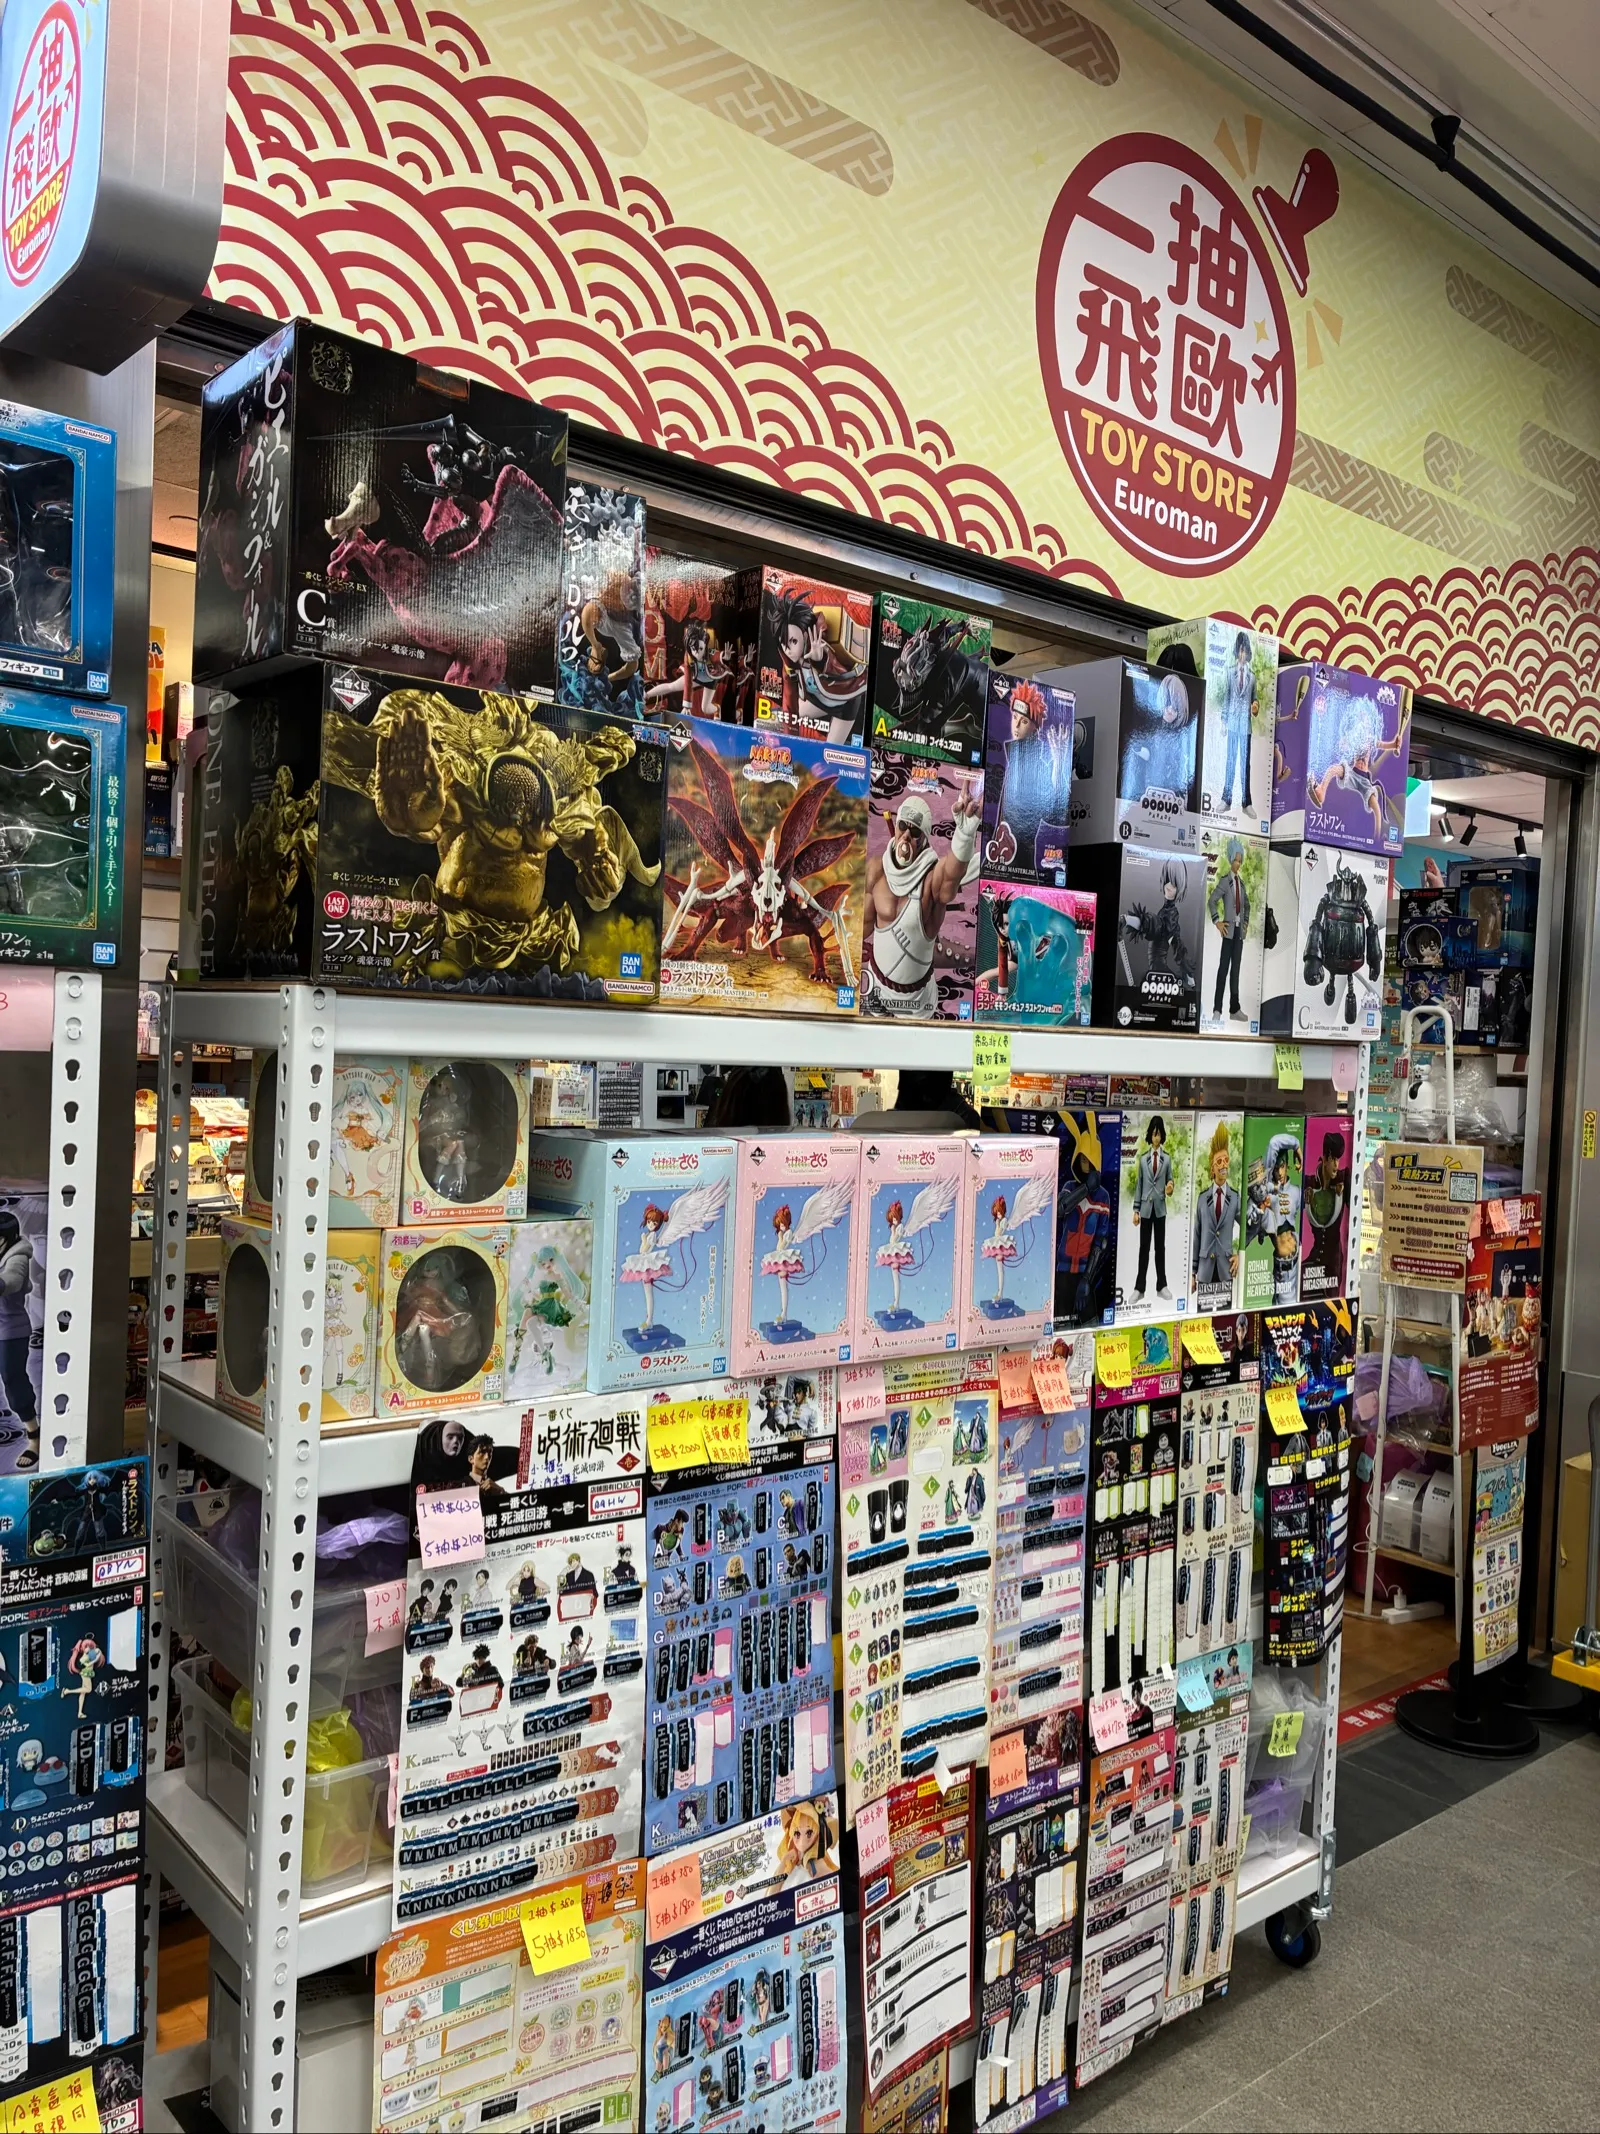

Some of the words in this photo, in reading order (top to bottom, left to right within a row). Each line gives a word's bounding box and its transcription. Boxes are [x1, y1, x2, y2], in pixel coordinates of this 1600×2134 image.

[13, 19, 64, 124] 一抽
[10, 95, 63, 218] 飛歐
[9, 209, 31, 252] TOY
[29, 171, 64, 232] STORE
[17, 221, 50, 268] Euroman
[1078, 184, 1249, 330] 一抽
[1075, 263, 1249, 458] 飛歐
[68, 426, 89, 437] BANDAI
[90, 431, 109, 441] NAMCO
[1080, 408, 1147, 474] TOY
[1152, 442, 1254, 521] STORE
[1114, 477, 1217, 546] Euroman
[356, 583, 368, 593] EX
[74, 708, 97, 717] BANDAI
[98, 713, 118, 721] NAMCO
[777, 713, 790, 722] モモ
[204, 698, 226, 811] ONE
[750, 745, 792, 765] NARUTO
[826, 752, 845, 762] BANDAI
[845, 754, 864, 765] NAMCO
[1142, 797, 1179, 815] POPUP
[1148, 812, 1172, 822] PARADE
[324, 872, 350, 883] 一番くじ
[354, 874, 387, 885] ワンピース
[388, 878, 400, 887] EX
[199, 828, 219, 974] PIECE
[327, 895, 347, 905] LAST
[328, 904, 346, 913] ONE
[323, 954, 353, 964] センゴク
[622, 956, 640, 965] BAN
[622, 965, 637, 974] DAI
[608, 983, 630, 991] BANDAI
[631, 986, 652, 994] NAMCO
[1141, 981, 1180, 996] POPUP
[1148, 995, 1172, 1003] PARADE
[678, 1152, 699, 1171] さくら
[810, 1152, 828, 1168] さくら
[919, 1151, 936, 1166] さくら
[1019, 1149, 1034, 1163] さくら
[1394, 1155, 1413, 1168] 會員
[1402, 1168, 1441, 1182] 集點方式
[1248, 1259, 1268, 1273] ROHAN
[1303, 1265, 1326, 1279] JOSUKE
[1246, 1283, 1275, 1298] HEAVEN'S
[1275, 1281, 1292, 1294] DOOR
[1302, 1277, 1339, 1292] HIGASHIKATA
[538, 1408, 572, 1422] 一番くじ
[537, 1414, 641, 1463] 呪術廻戦
[572, 1463, 605, 1476] 死滅回游
[590, 1479, 642, 1494] 店舗固有ID記入欄
[499, 1495, 538, 1508] 一番くじ
[1274, 1501, 1308, 1512] VIGILANTES
[500, 1506, 549, 1524] 死滅回游
[30, 1801, 95, 1824] ちょこのっこフィギュア
[83, 1856, 141, 1877] クリアファイルセット
[12, 1878, 59, 1897] ラバーチャーム
[692, 1923, 717, 1940] 一番くじ
[716, 1908, 757, 1932] Fate/Grand
[757, 1899, 779, 1917] Order
